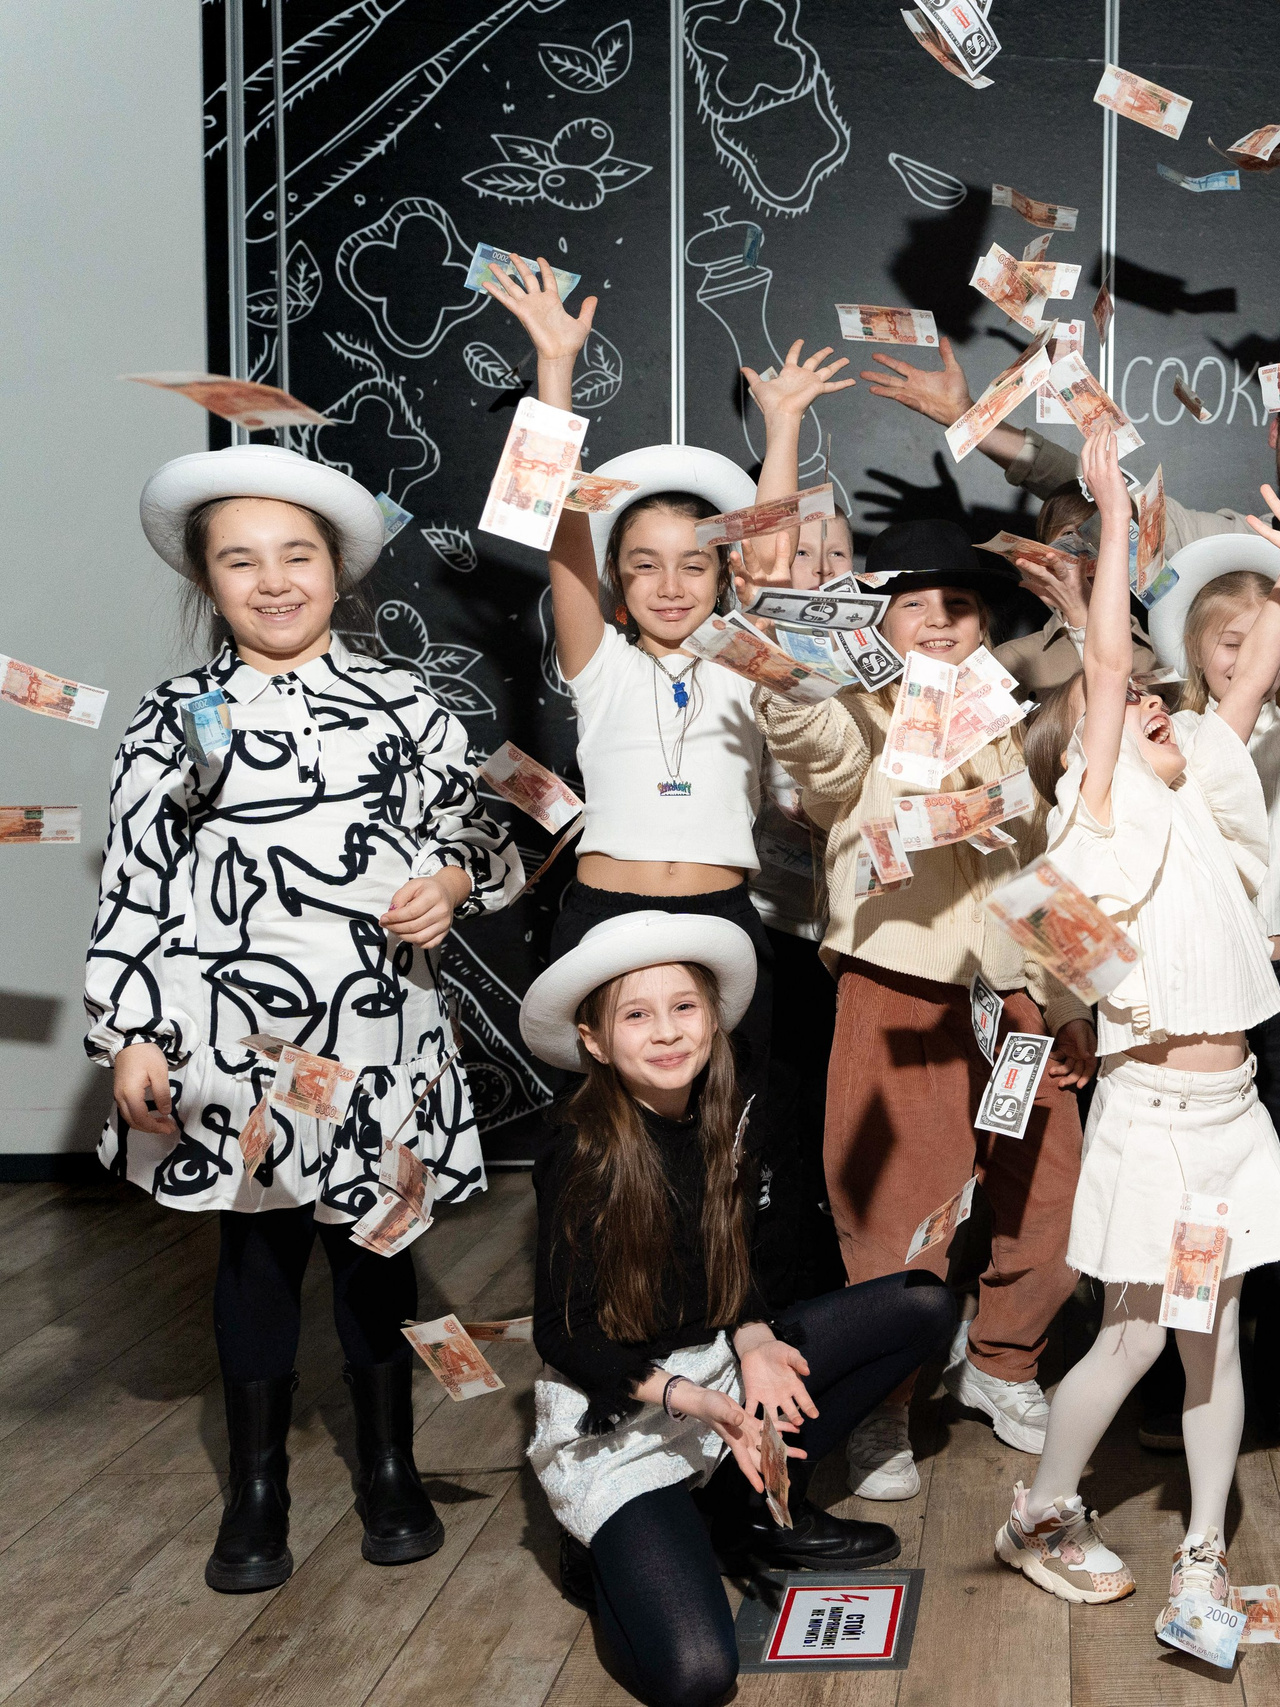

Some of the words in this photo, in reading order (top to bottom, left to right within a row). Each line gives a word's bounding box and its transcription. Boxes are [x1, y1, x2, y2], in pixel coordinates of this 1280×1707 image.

[985, 714, 1011, 737] 5000
[924, 795, 953, 806] 5000
[314, 1104, 338, 1119] 5000
[811, 1608, 826, 1617] НЕ
[1203, 1605, 1239, 1629] 2000
[802, 1618, 823, 1648] МОЧИТЬ!
[820, 1606, 845, 1650] НАПРЯЖЕНИЕ!
[841, 1613, 866, 1641] СТОЙ!
